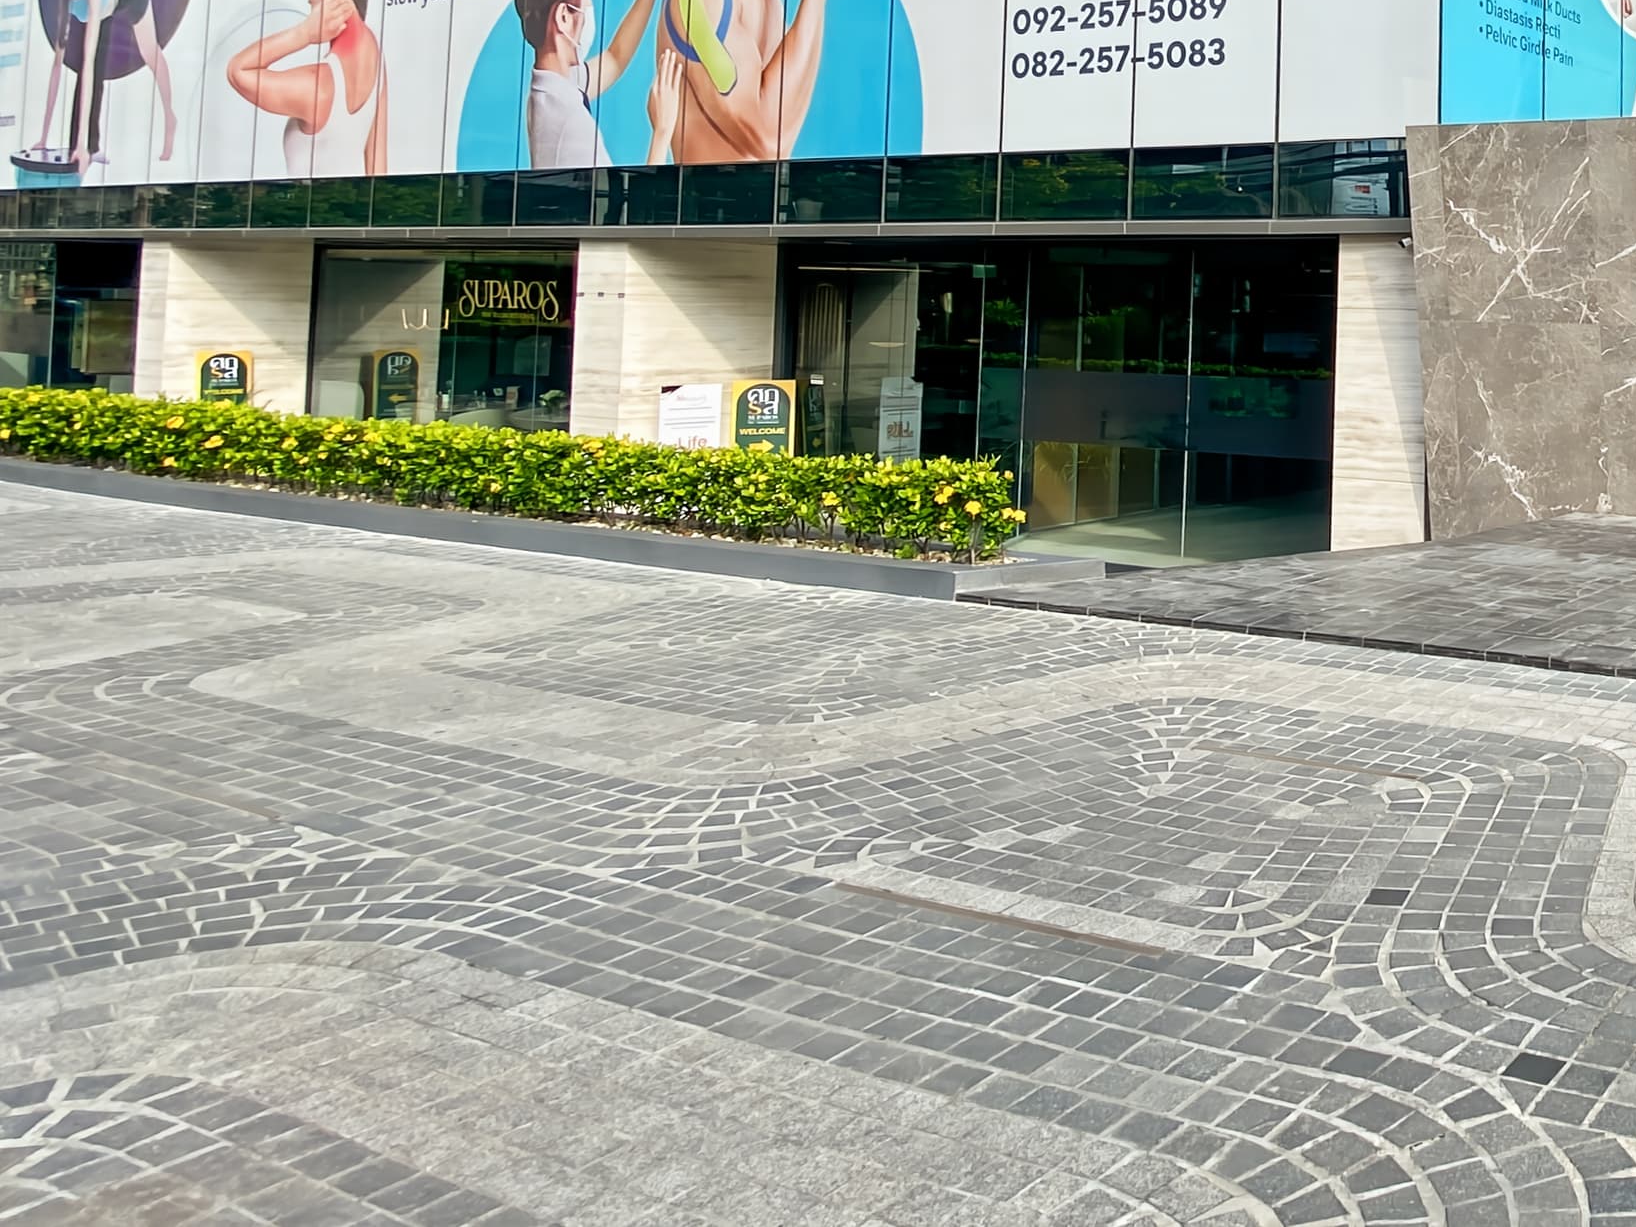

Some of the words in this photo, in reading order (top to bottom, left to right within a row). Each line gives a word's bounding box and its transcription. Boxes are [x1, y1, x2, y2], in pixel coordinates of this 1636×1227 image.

[1536, 16, 1561, 40] Recti
[1555, 0, 1581, 25] Ducts
[1012, 38, 1225, 78] 082-257-5083
[1485, 24, 1518, 49] Pelvic
[1520, 35, 1551, 59] Girde
[1553, 47, 1573, 68] Pain
[458, 279, 559, 321] SUPAROS
